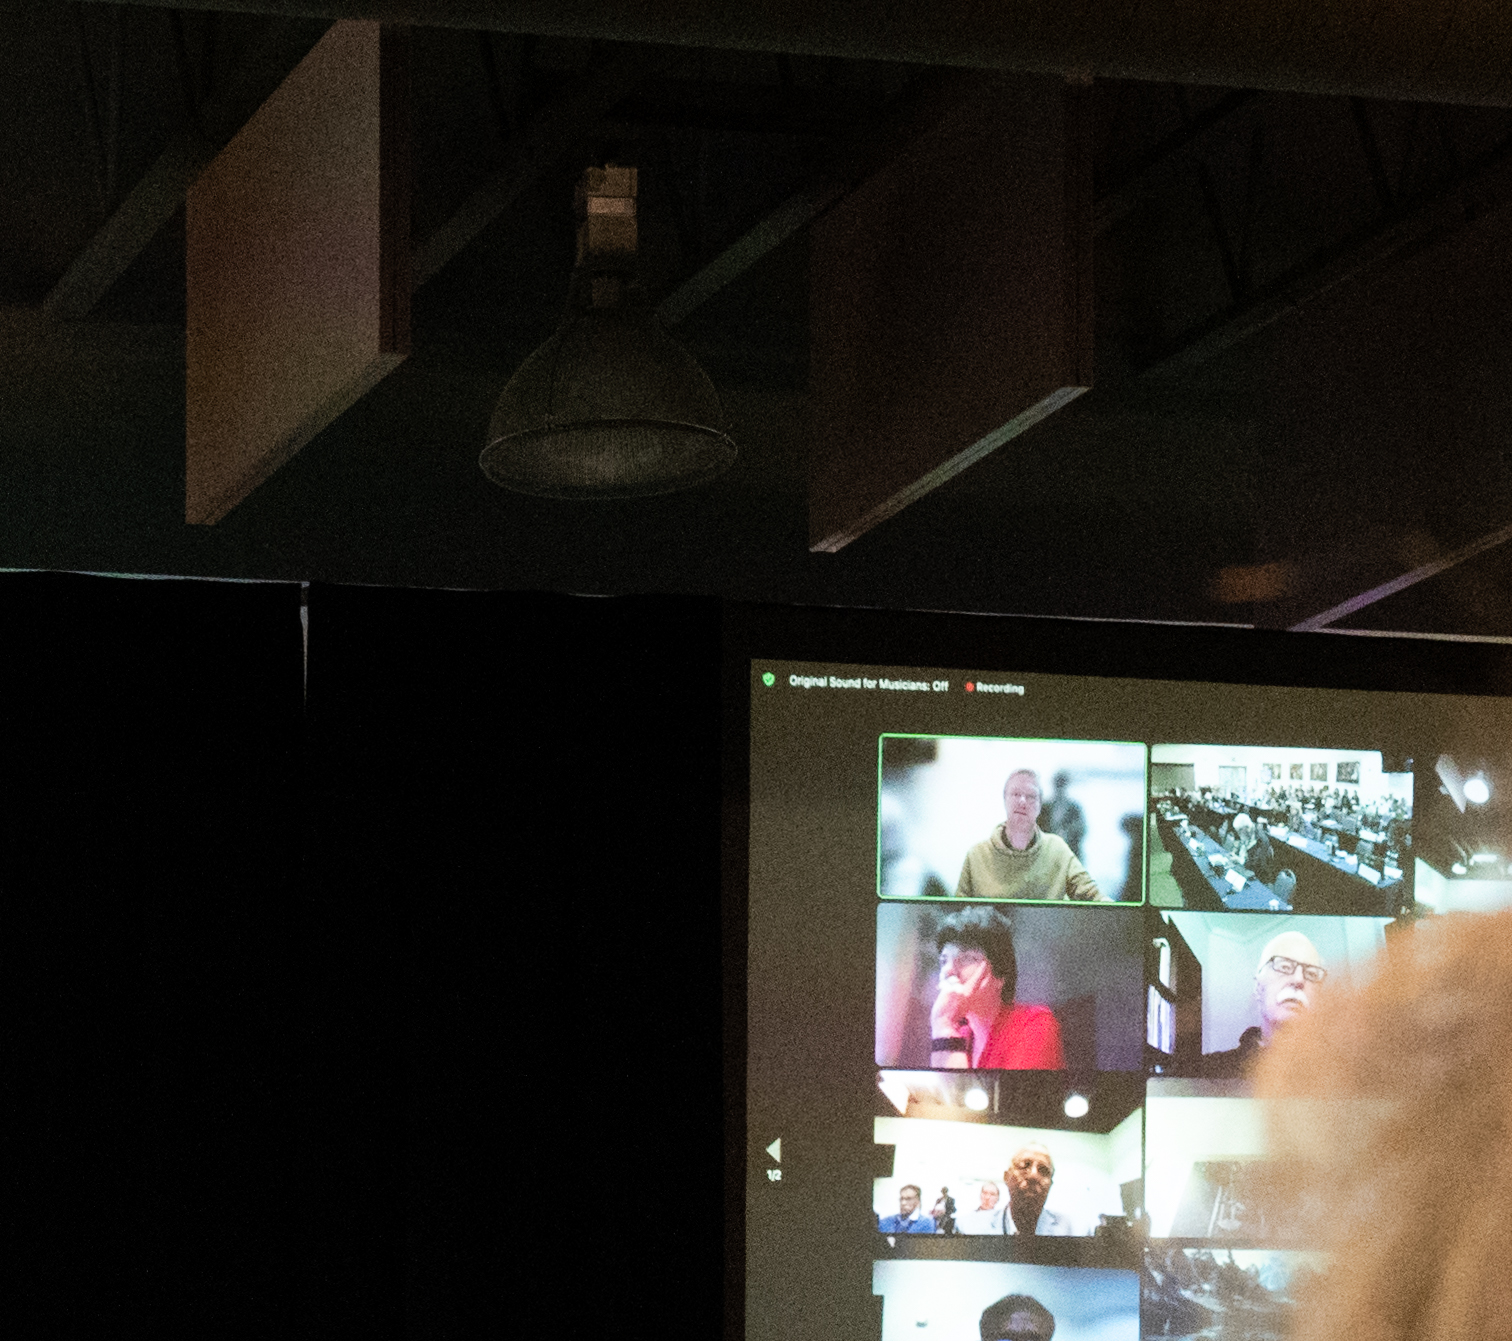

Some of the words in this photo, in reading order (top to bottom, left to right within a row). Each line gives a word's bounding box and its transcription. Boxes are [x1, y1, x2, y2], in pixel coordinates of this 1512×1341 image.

[789, 674, 827, 689] Original
[829, 676, 861, 688] Sound
[862, 677, 877, 689] for
[879, 678, 930, 691] Musicians:
[932, 680, 949, 692] Off
[976, 682, 1025, 696] Recording
[767, 1169, 782, 1182] 1/2
